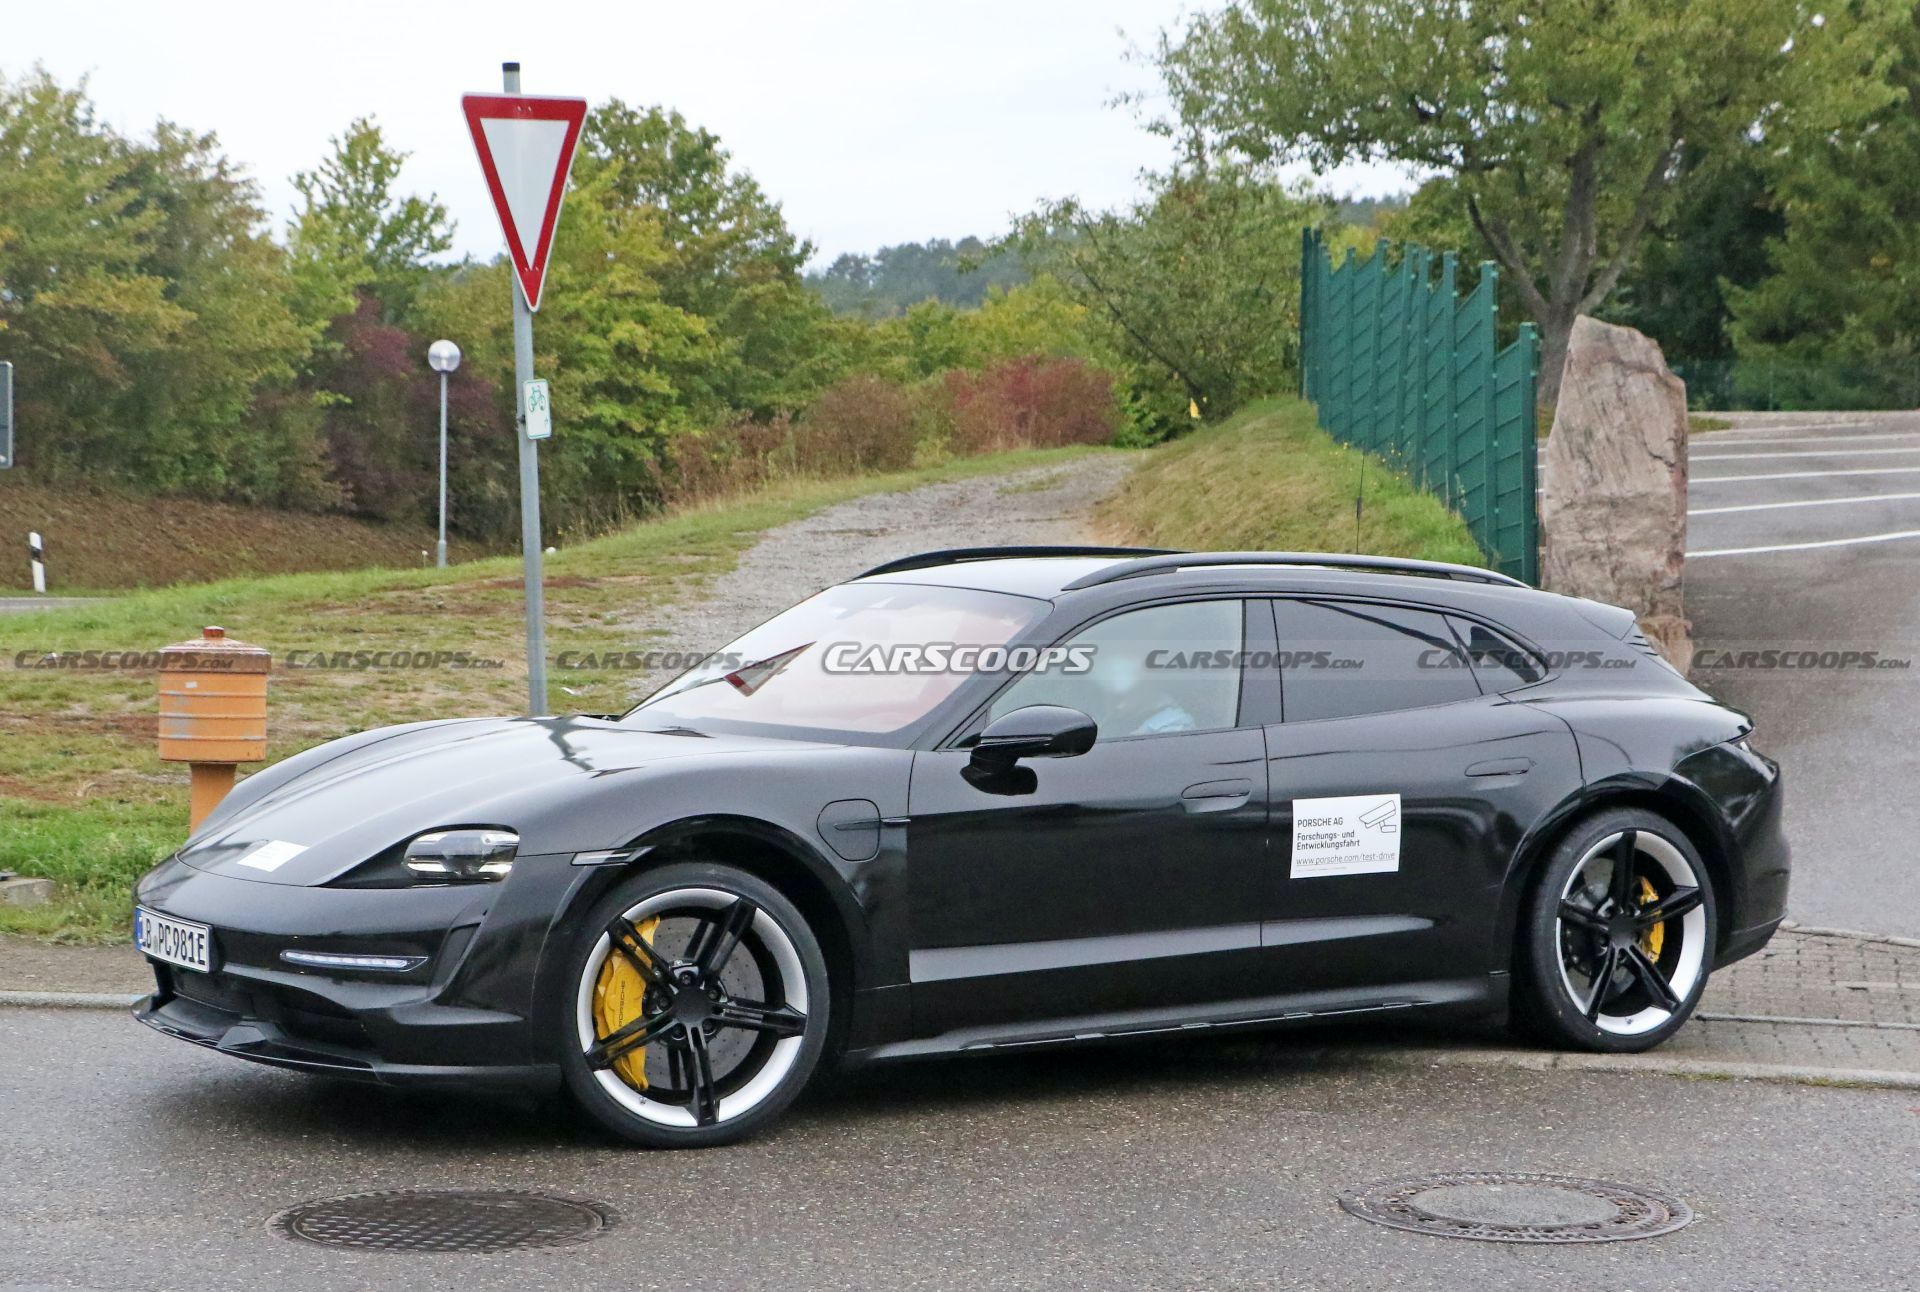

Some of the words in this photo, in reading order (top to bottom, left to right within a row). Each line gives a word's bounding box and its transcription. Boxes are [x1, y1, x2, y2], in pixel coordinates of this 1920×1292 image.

[1297, 818, 1332, 828] PORSCHE
[1333, 817, 1344, 826] AG
[1297, 832, 1340, 842] Forschungs-
[1341, 830, 1355, 839] und
[1296, 839, 1360, 850] Entwicklungsfahrt
[1296, 852, 1396, 865] www.porsche.com/test-drive
